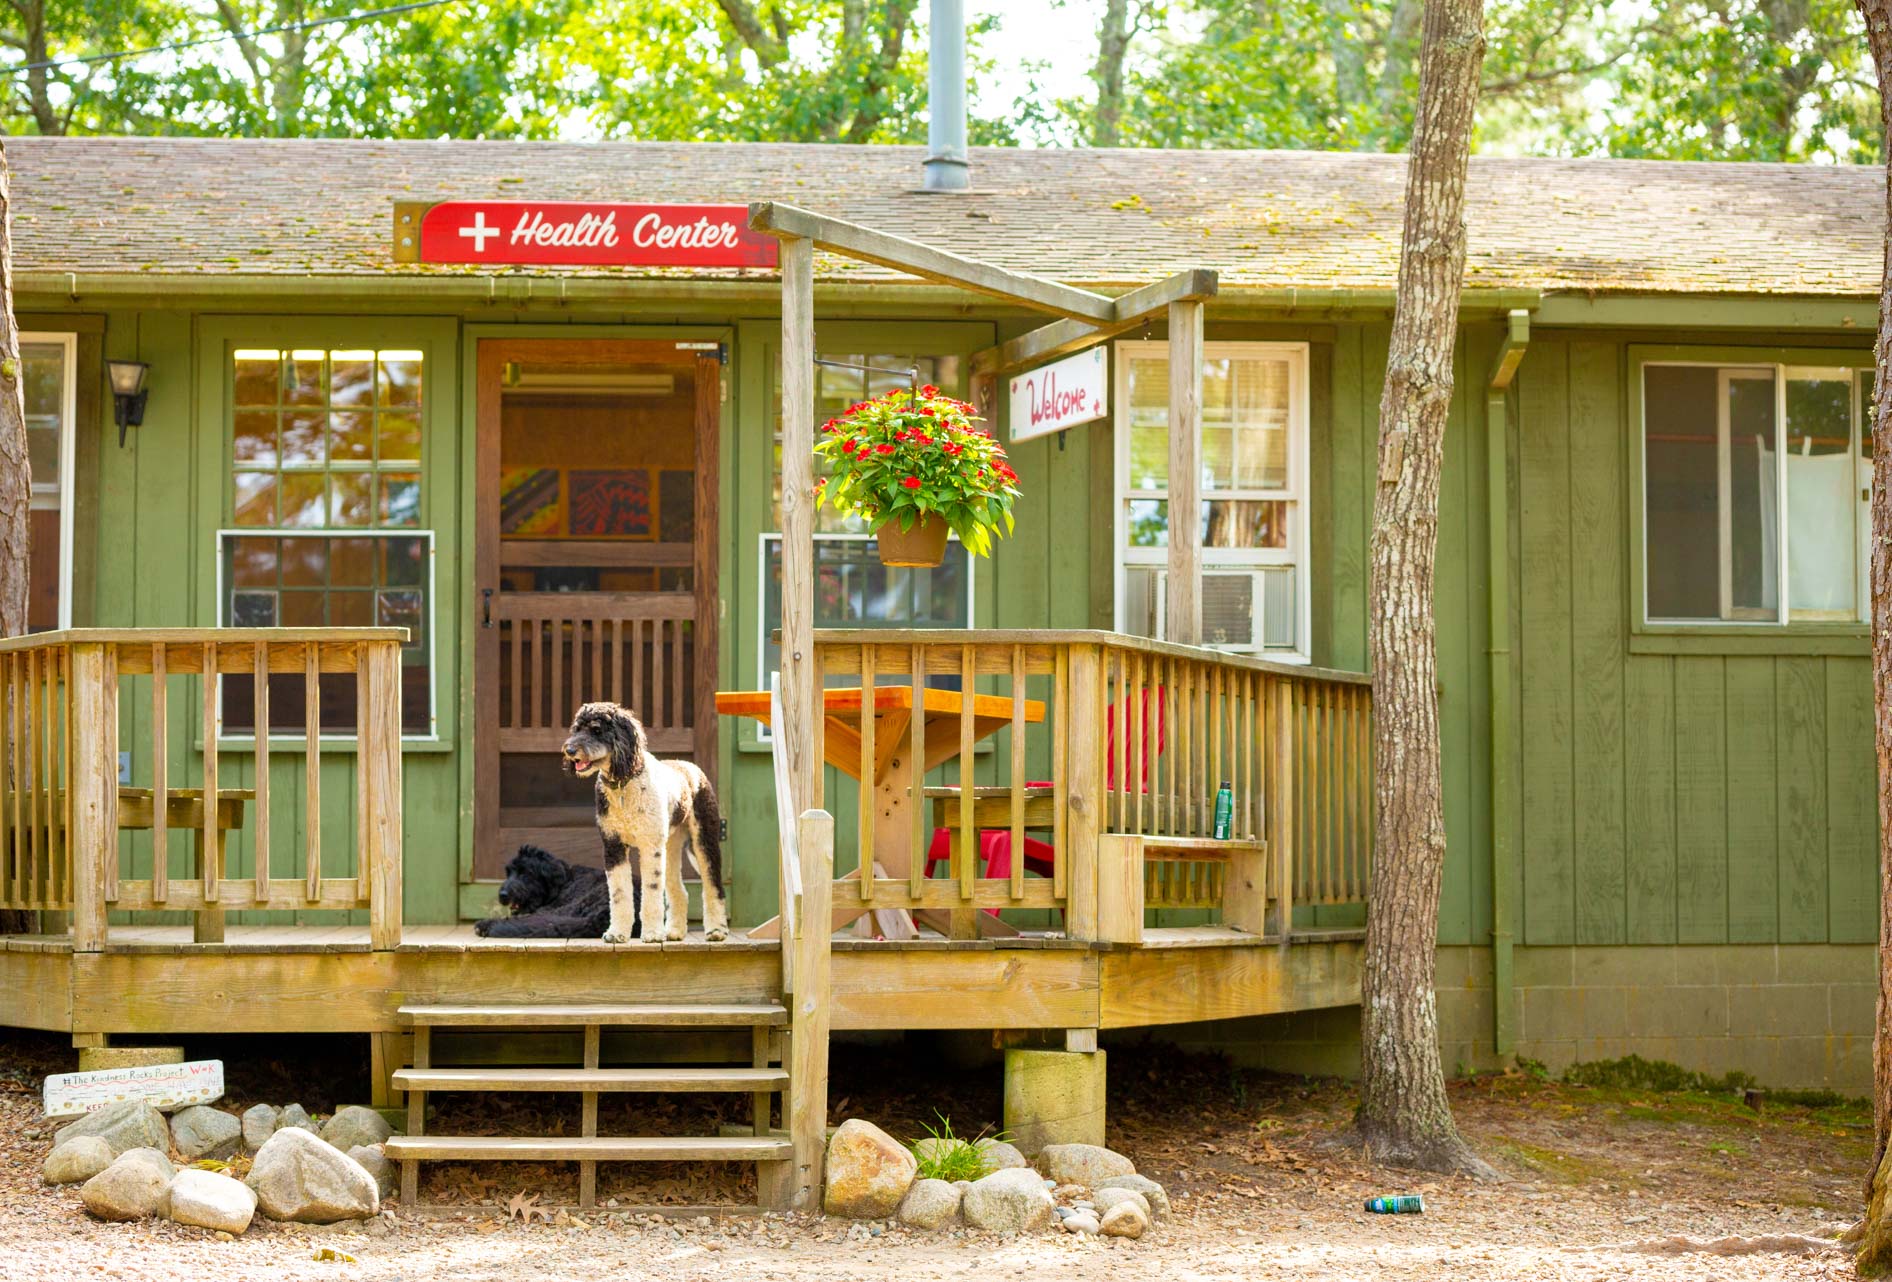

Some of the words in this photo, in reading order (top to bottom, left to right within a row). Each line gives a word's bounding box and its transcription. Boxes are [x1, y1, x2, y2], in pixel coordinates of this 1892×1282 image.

[510, 210, 619, 247] Health
[632, 212, 739, 248] Center
[91, 1073, 126, 1083] Kindness
[129, 1070, 153, 1080] Rocks
[155, 1067, 184, 1078] Project
